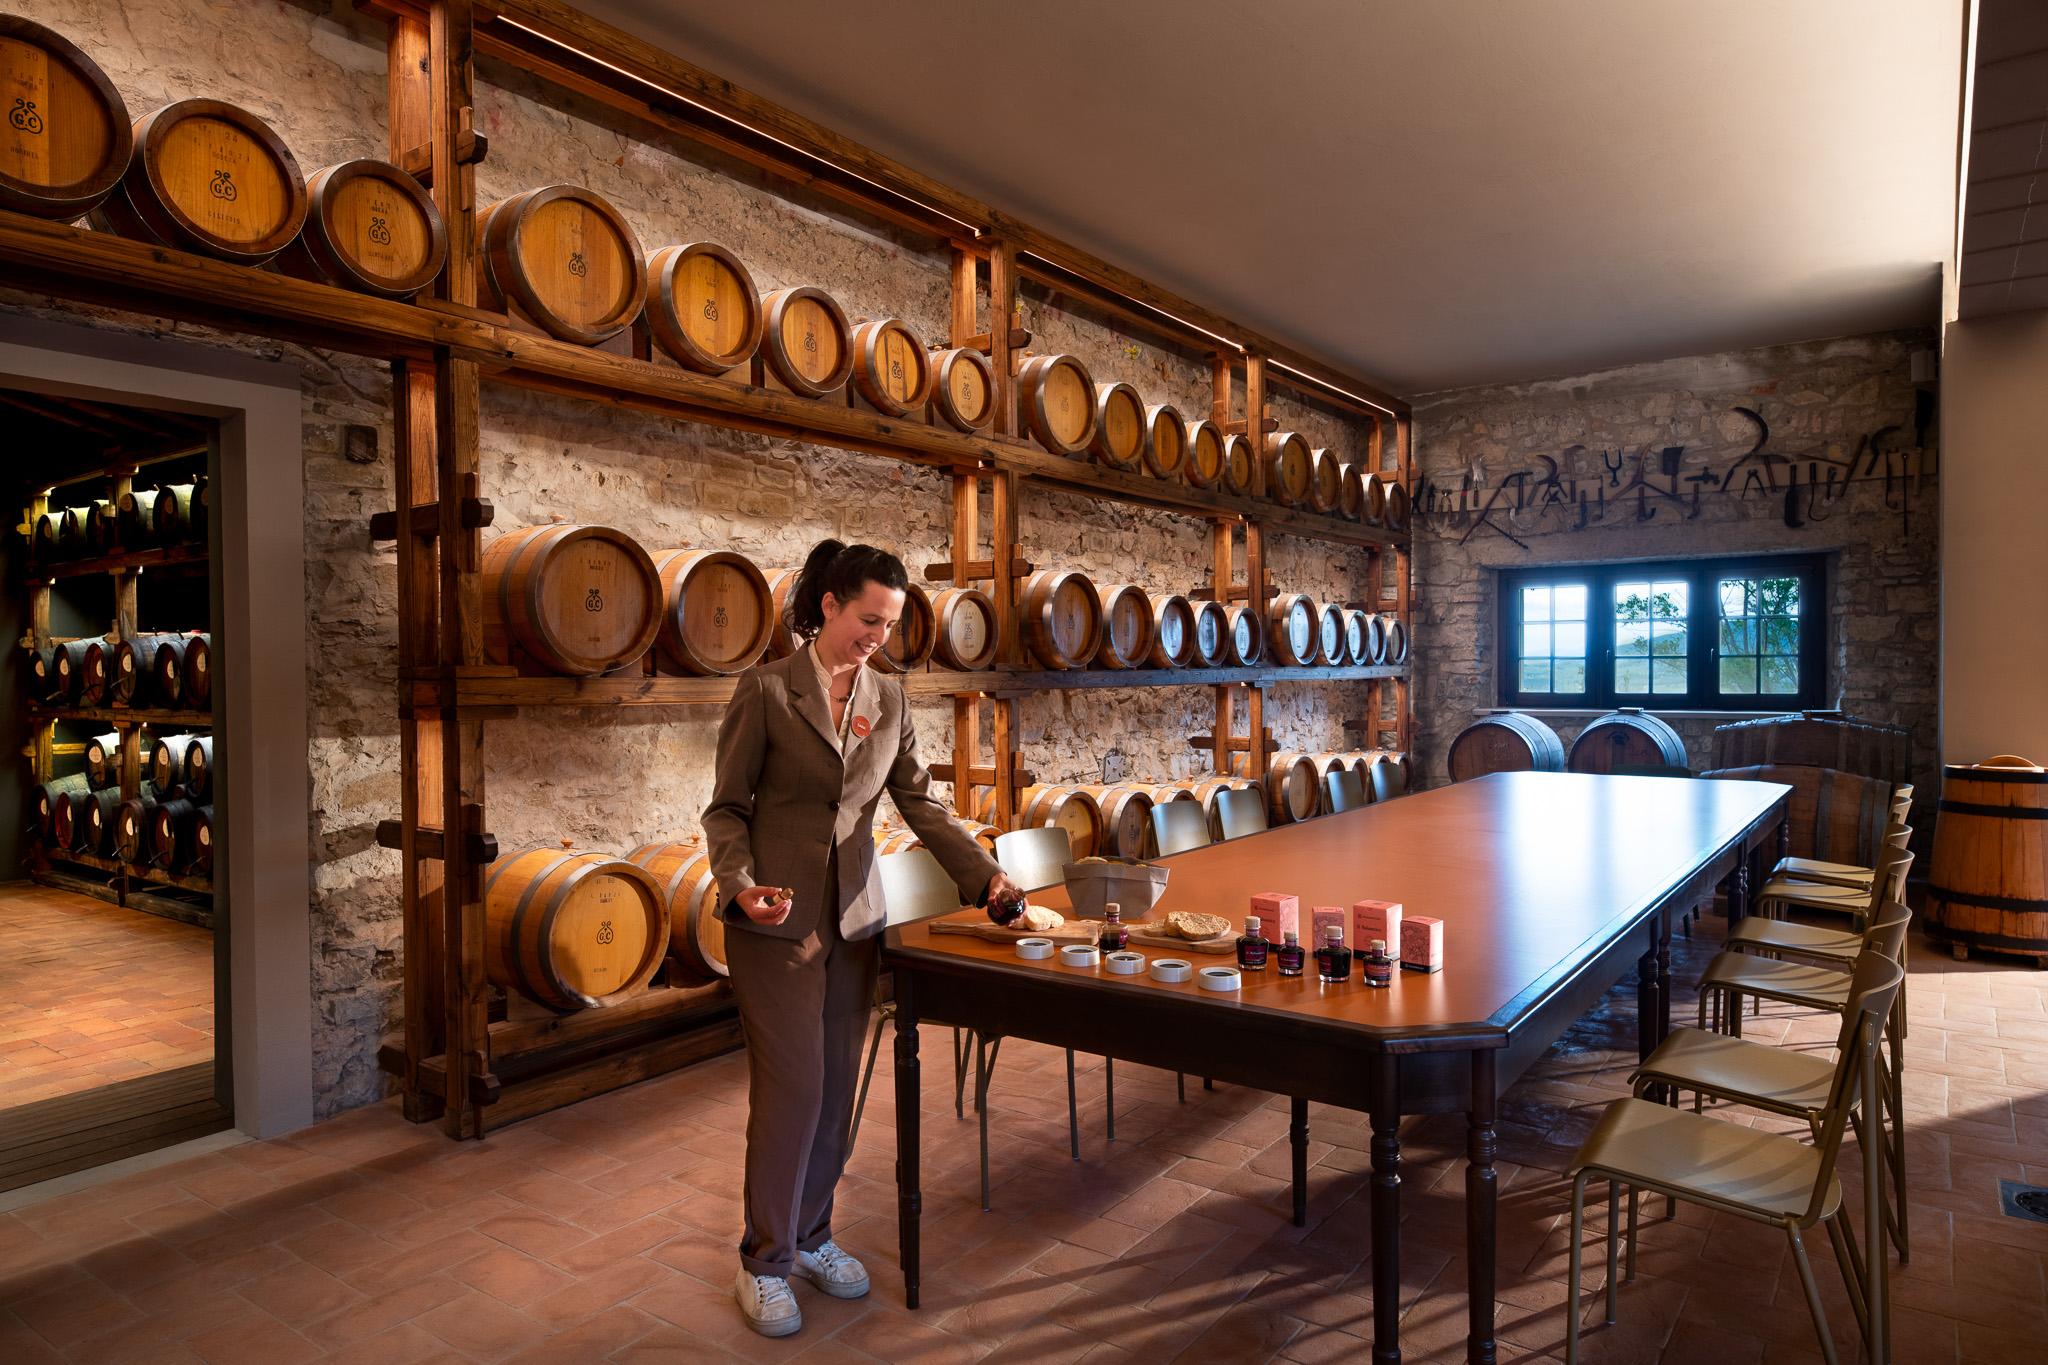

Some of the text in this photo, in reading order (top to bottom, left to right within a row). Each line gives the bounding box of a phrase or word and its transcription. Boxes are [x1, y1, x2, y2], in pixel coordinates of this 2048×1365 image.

[15, 113, 37, 129] G.C
[214, 183, 232, 196] G.C
[372, 229, 387, 241] G.C
